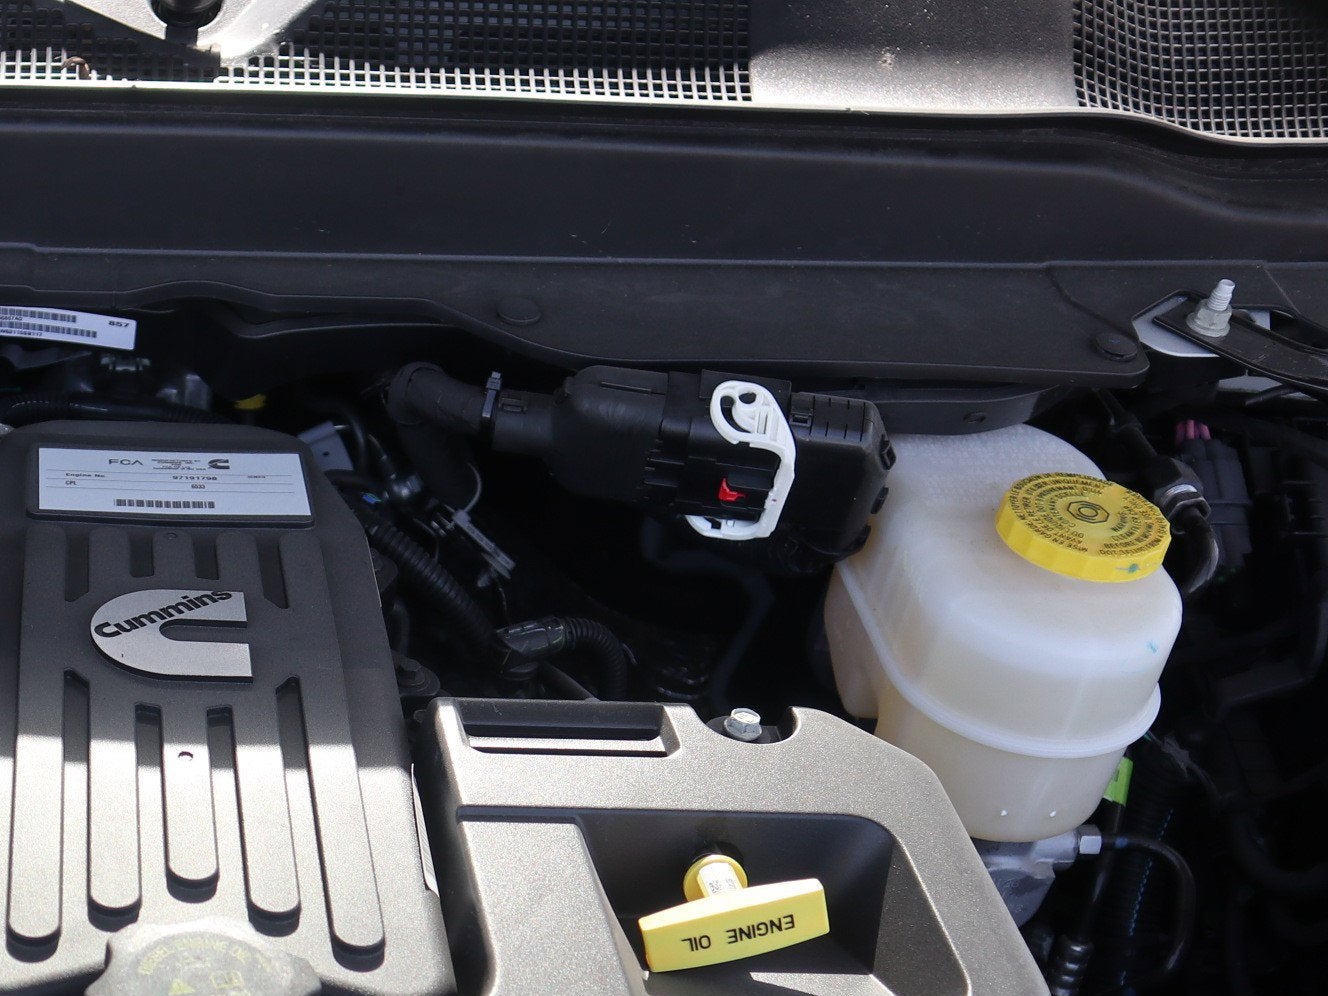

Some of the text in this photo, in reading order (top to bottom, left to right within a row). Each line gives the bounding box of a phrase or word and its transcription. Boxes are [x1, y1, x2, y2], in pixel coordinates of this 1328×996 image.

[108, 458, 144, 466] FCA
[94, 591, 233, 638] Cummins
[681, 914, 795, 952] ENGINE OIL
